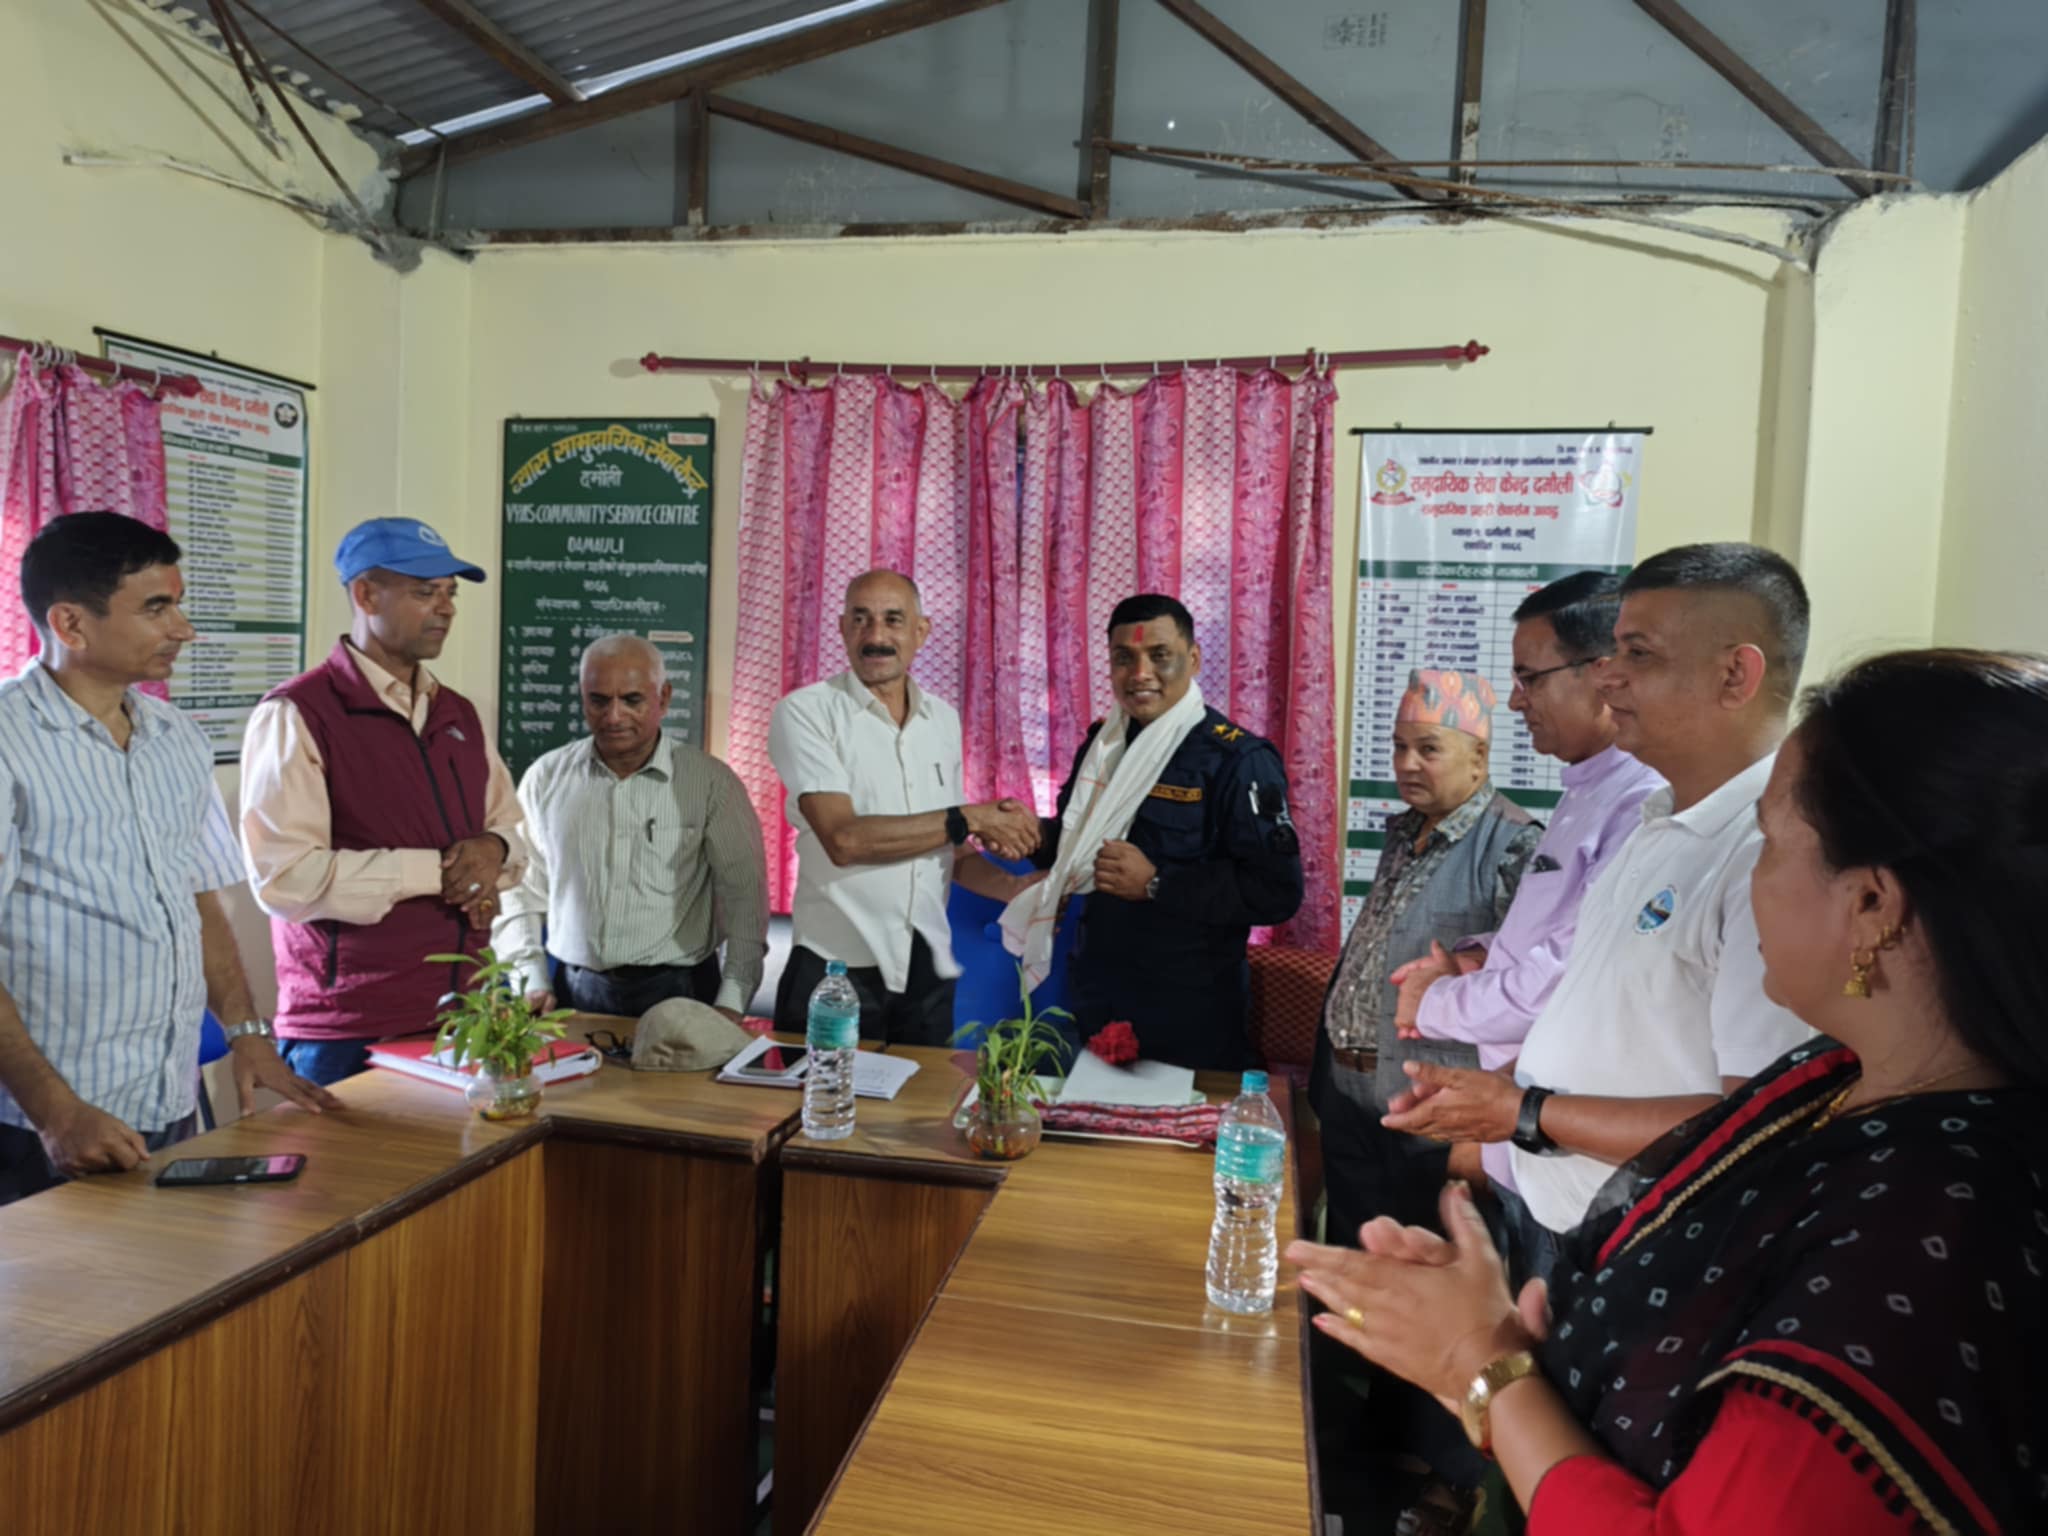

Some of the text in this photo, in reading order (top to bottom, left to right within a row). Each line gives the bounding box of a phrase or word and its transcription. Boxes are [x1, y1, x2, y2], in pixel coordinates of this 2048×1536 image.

[1474, 471, 1496, 494] सेवा
[1533, 471, 1574, 495] दमौली
[606, 503, 653, 525] SERVICE
[653, 503, 701, 525] CENTRE
